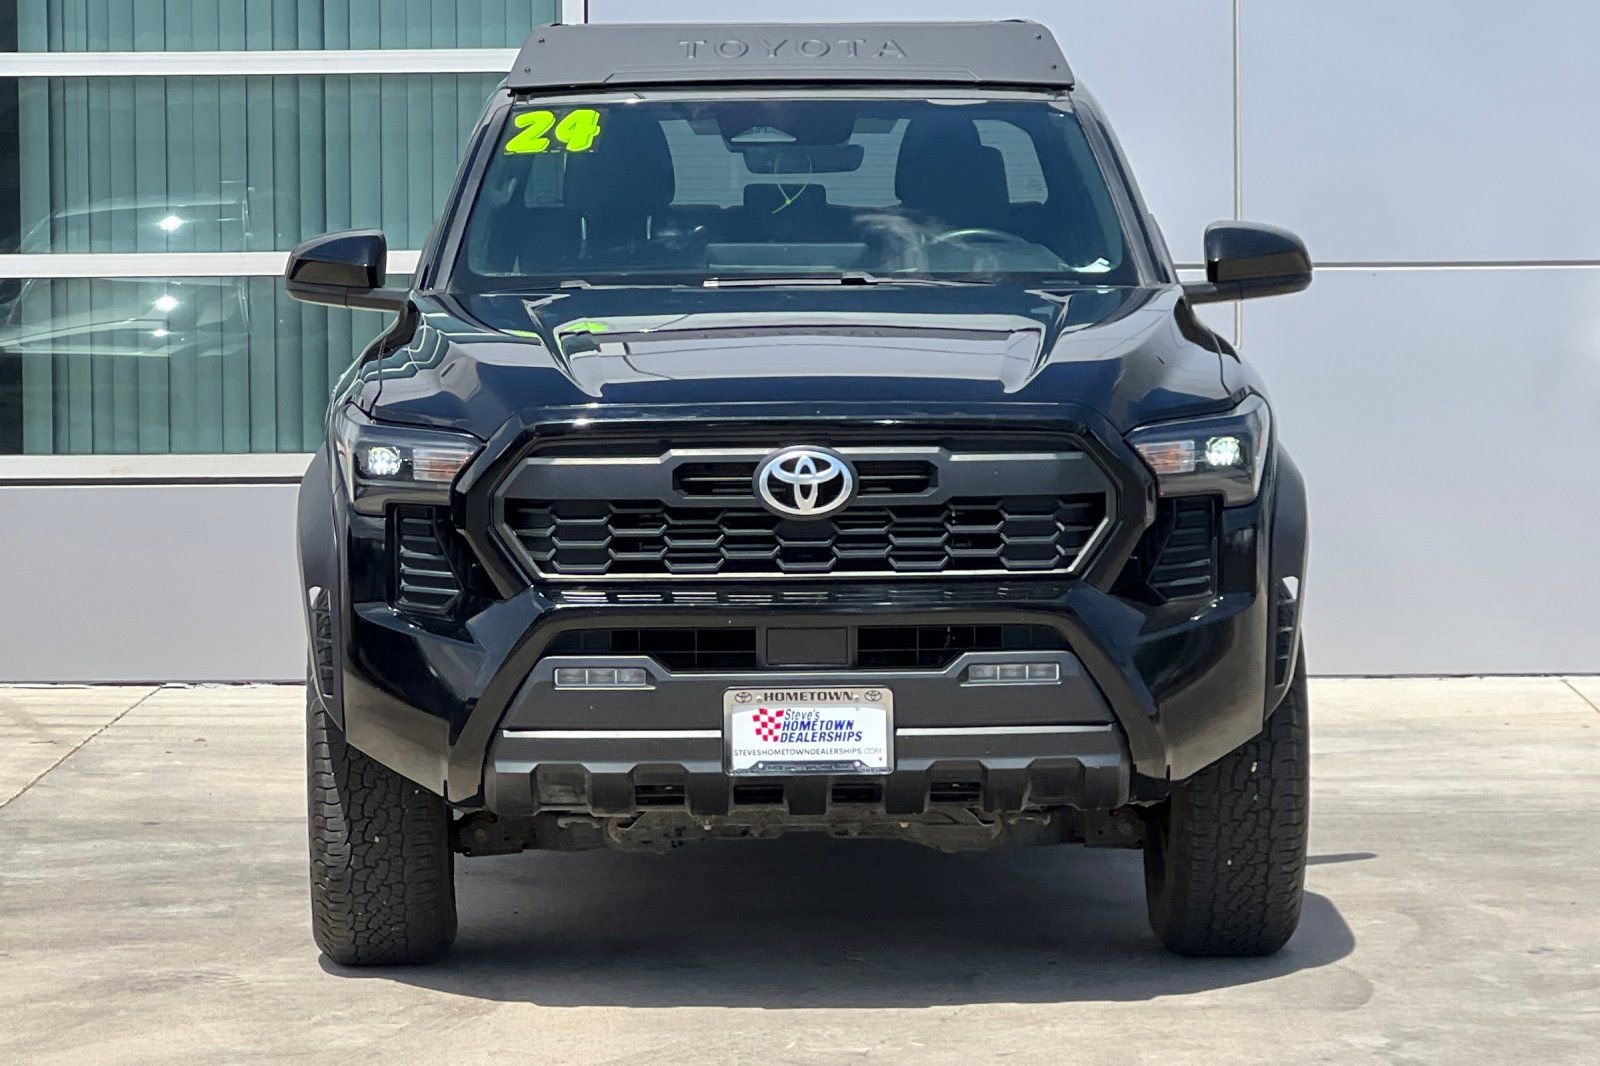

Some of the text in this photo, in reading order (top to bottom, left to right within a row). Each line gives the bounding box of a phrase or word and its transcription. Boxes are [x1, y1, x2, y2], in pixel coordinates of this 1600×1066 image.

[680, 38, 910, 58] TOYOTA
[505, 109, 601, 153] 24
[764, 691, 853, 702] HOMETOWN
[784, 709, 820, 721] Steve's
[782, 720, 854, 732] HOMETOWN
[780, 731, 863, 743] DEALERSHIPS
